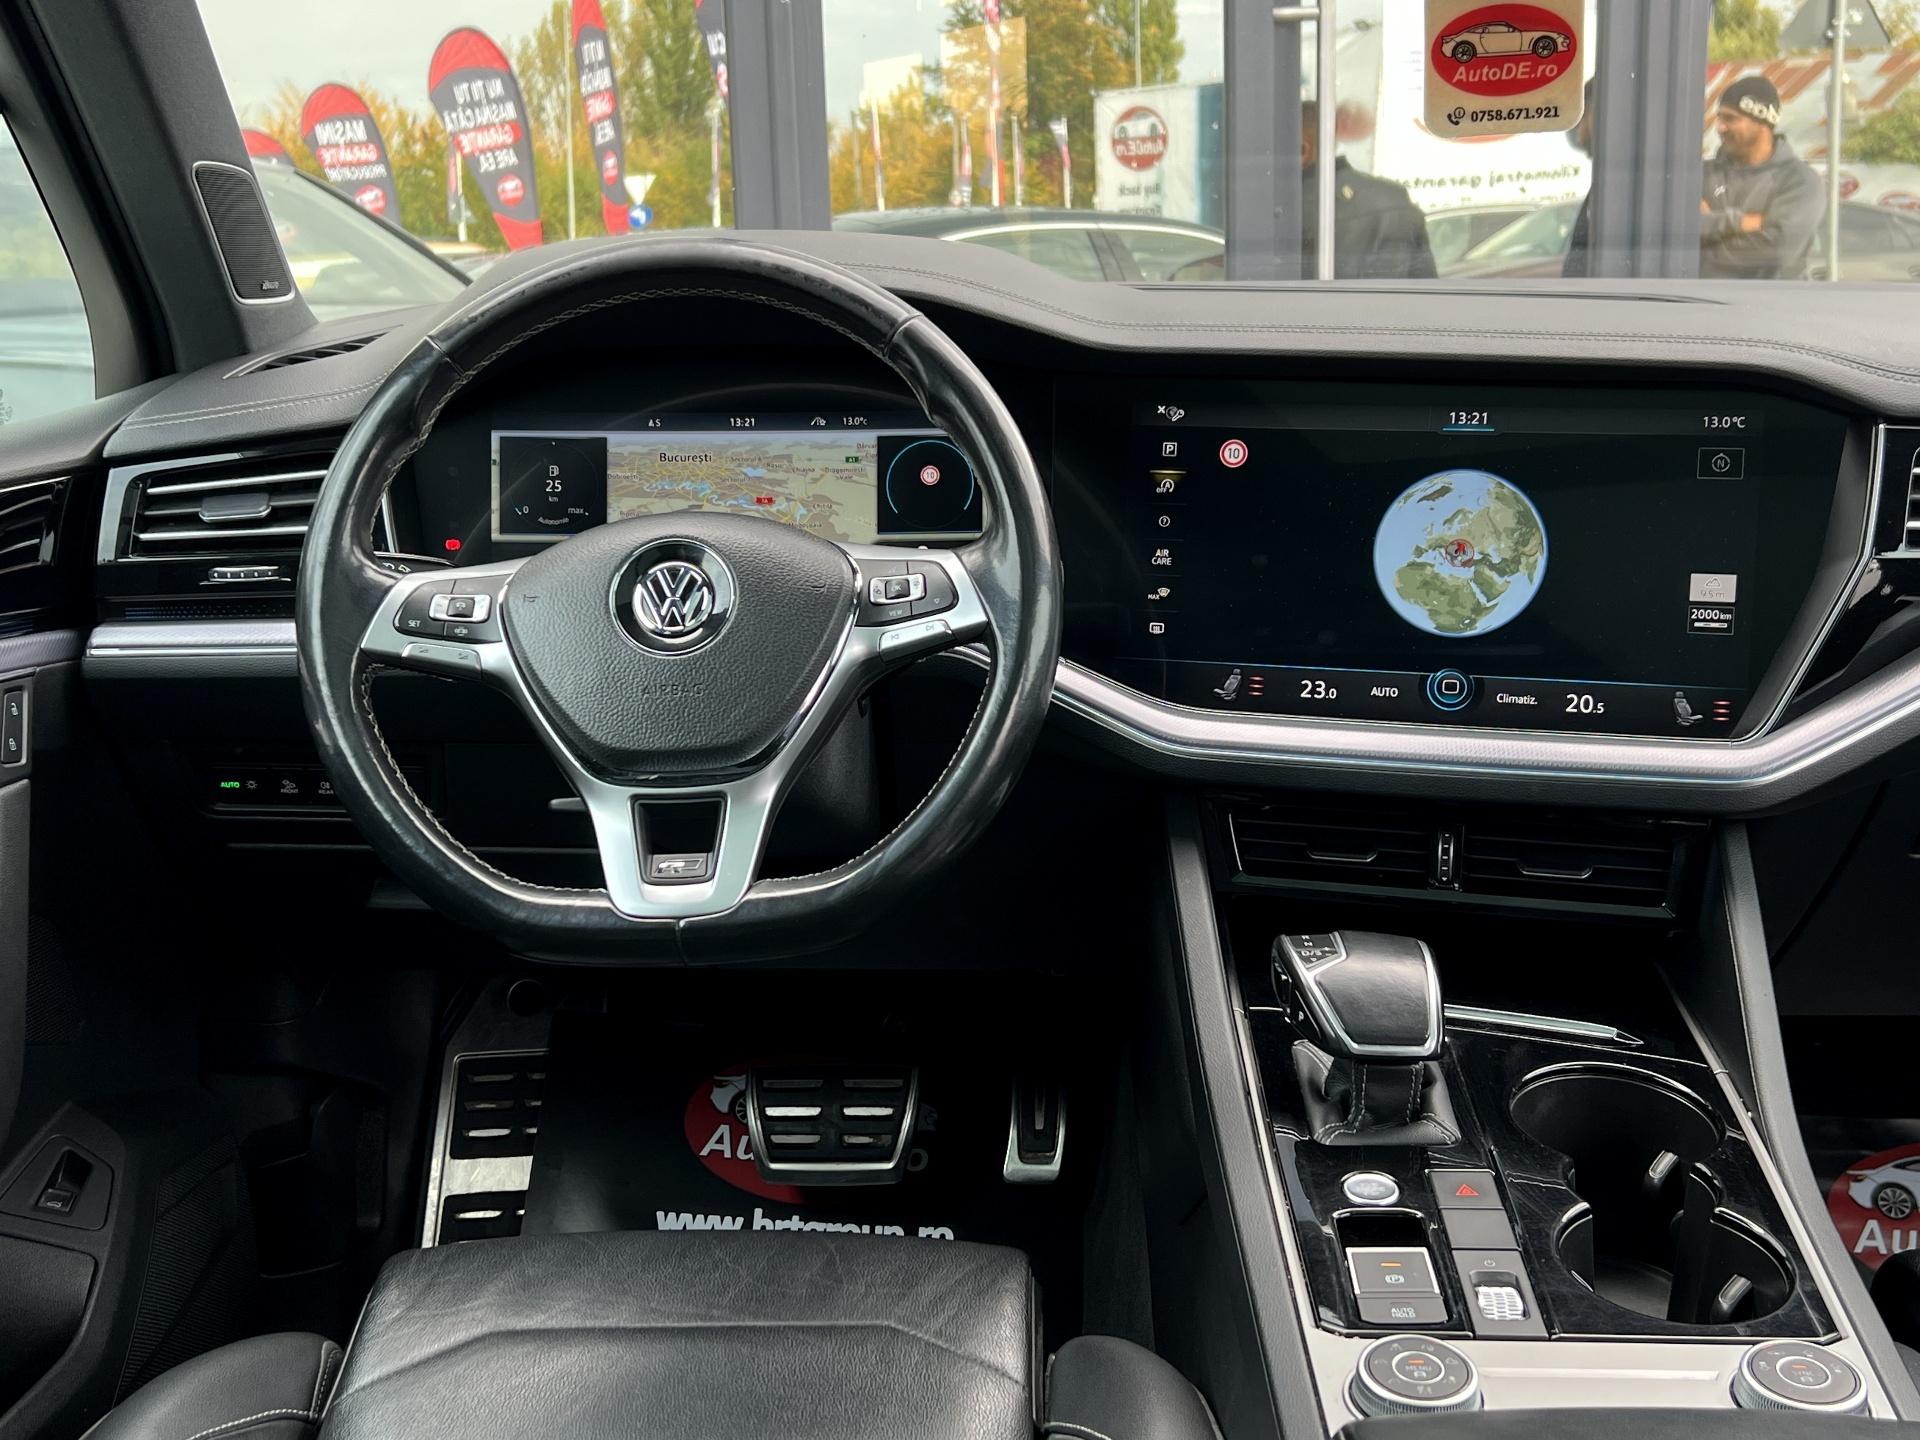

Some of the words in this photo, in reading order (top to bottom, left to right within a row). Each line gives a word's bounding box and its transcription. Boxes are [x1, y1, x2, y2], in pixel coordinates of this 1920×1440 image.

[1452, 62, 1557, 83] AutoDE.ro
[1471, 106, 1560, 122] 0758.671.921
[730, 417, 755, 427] 13:21
[1449, 411, 1488, 425] 13:21
[1703, 416, 1746, 428] 13.0°C
[659, 452, 712, 464] București
[1227, 447, 1240, 459] 10
[545, 480, 562, 492] 25
[1155, 549, 1169, 557] AIR
[1151, 557, 1172, 565] CARE
[408, 620, 421, 628] SET
[1300, 680, 1337, 699] 23.0
[1370, 686, 1399, 697] AUTO
[1496, 693, 1538, 705] Climatiz.
[1565, 693, 1605, 714] 20.5
